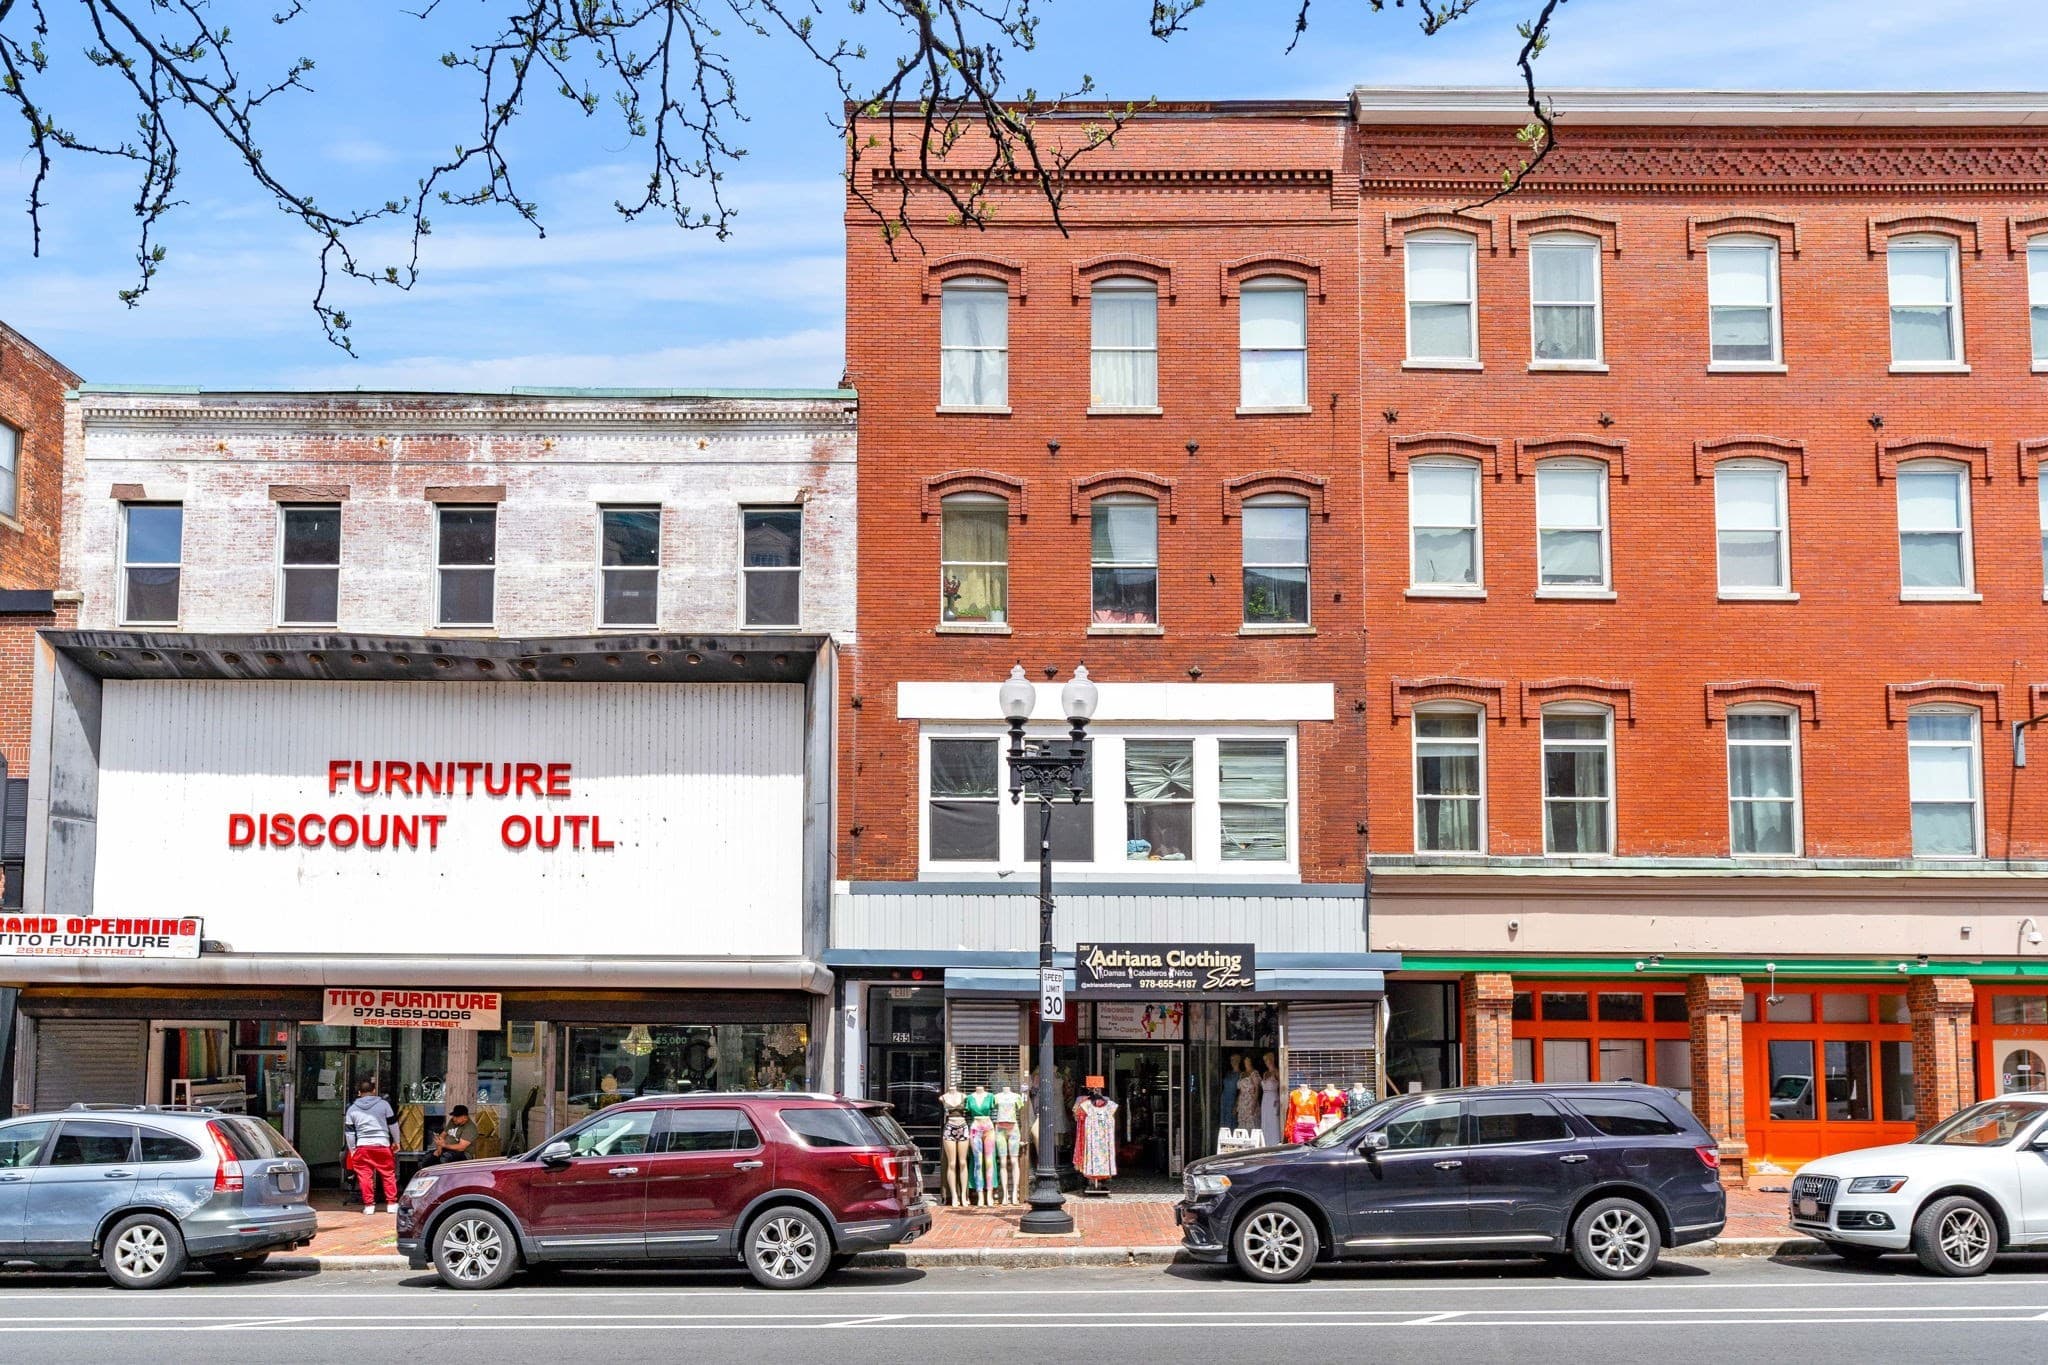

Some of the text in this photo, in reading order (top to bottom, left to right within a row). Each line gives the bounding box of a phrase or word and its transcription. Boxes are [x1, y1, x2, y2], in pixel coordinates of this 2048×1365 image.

[328, 760, 572, 797] FURNITURE
[228, 813, 615, 849] DISCOUNT OUTL
[66, 918, 197, 936] OPENNING
[50, 935, 170, 948] FURNITURE
[47, 947, 91, 955] ESSEX
[94, 948, 145, 956] STREET
[1092, 950, 1242, 971] Adriana Clothing
[1044, 973, 1062, 982] SPEED
[1103, 969, 1193, 977] Damas Caballeros Niños
[1202, 967, 1254, 990] Store
[1046, 984, 1060, 993] LIMIT
[1139, 980, 1197, 989] 978-655-4187
[328, 991, 497, 1010] TITO FURNITURE
[1044, 996, 1062, 1015] 30
[353, 1008, 472, 1020] 978-659-0096
[386, 1019, 420, 1027] ESSEX
